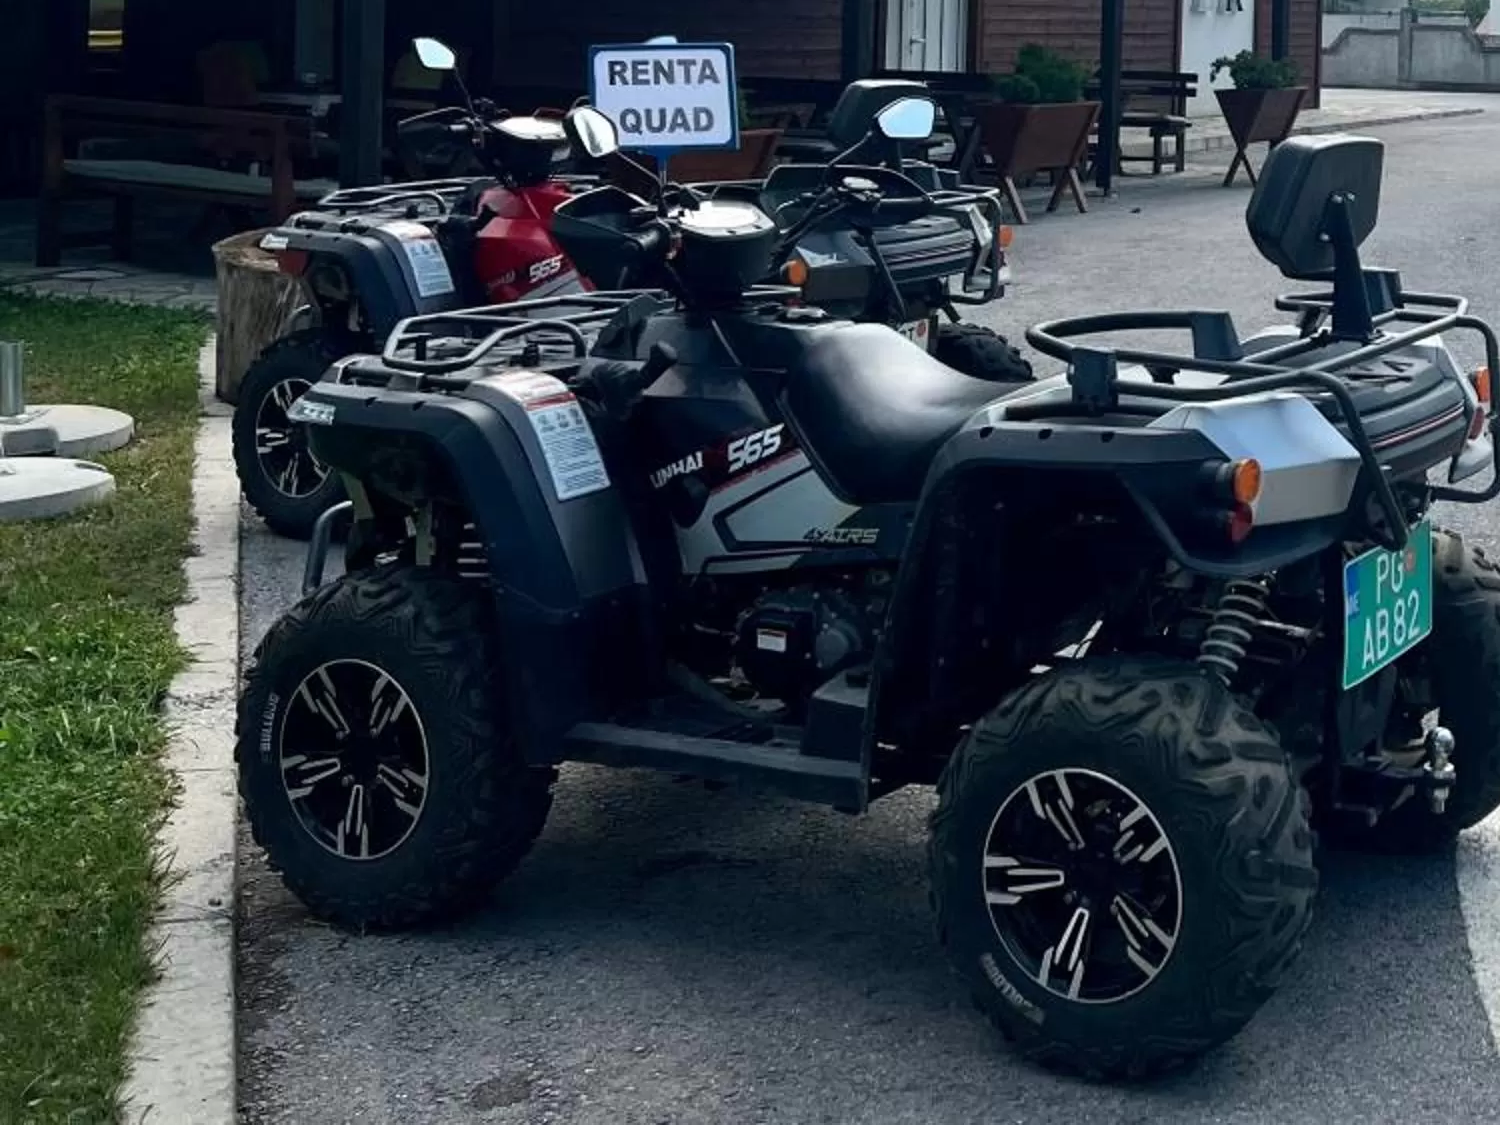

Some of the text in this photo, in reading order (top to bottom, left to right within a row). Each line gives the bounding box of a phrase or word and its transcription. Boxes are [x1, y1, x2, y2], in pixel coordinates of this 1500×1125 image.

[619, 106, 715, 135] QUAD
[727, 423, 785, 473] 565
[1376, 551, 1404, 604] PG
